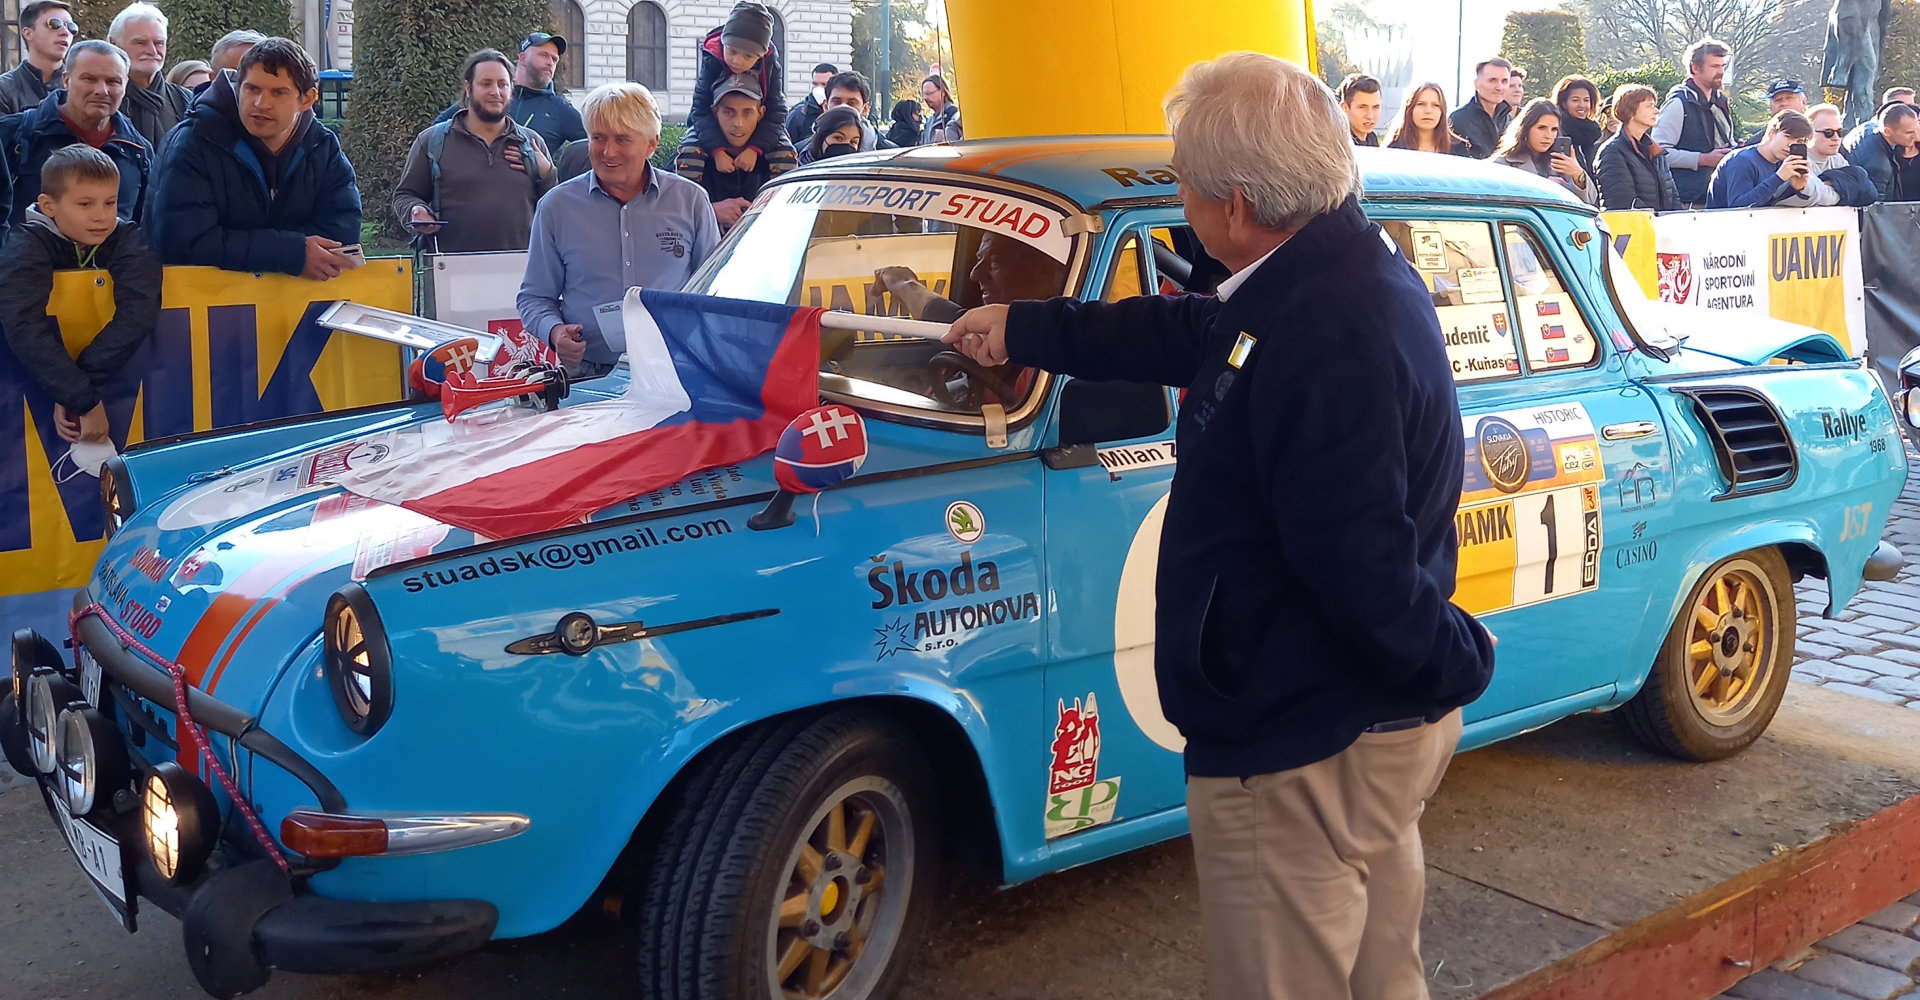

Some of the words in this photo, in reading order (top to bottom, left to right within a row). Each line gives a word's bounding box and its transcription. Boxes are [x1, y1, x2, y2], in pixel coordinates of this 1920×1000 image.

[1100, 165, 1178, 187] Ra
[787, 185, 941, 212] MOTORSPORT
[940, 193, 1051, 239] STUAD
[1703, 251, 1746, 270] NÁRODNÍ
[1771, 233, 1844, 282] UAMK
[1705, 270, 1755, 290] SPORTOVNÍ
[1707, 294, 1754, 310] AGENTURA
[1444, 325, 1490, 346] udenič
[1532, 407, 1583, 425] HISTORIC
[1821, 408, 1867, 441] Rallye
[1869, 438, 1886, 455] 1968
[1098, 448, 1164, 468] Milan
[402, 517, 733, 593] stuadsk@gmail.com
[1540, 494, 1558, 594] 1
[1583, 517, 1598, 583] EDDA
[1616, 541, 1657, 569] CASINO
[868, 550, 1001, 610] Škoda
[120, 599, 163, 639] STUAD
[913, 592, 1039, 640] AUTONOVA
[925, 639, 959, 652] s.r.o.
[1053, 763, 1093, 785] NG
[1053, 777, 1092, 791] TOOL
